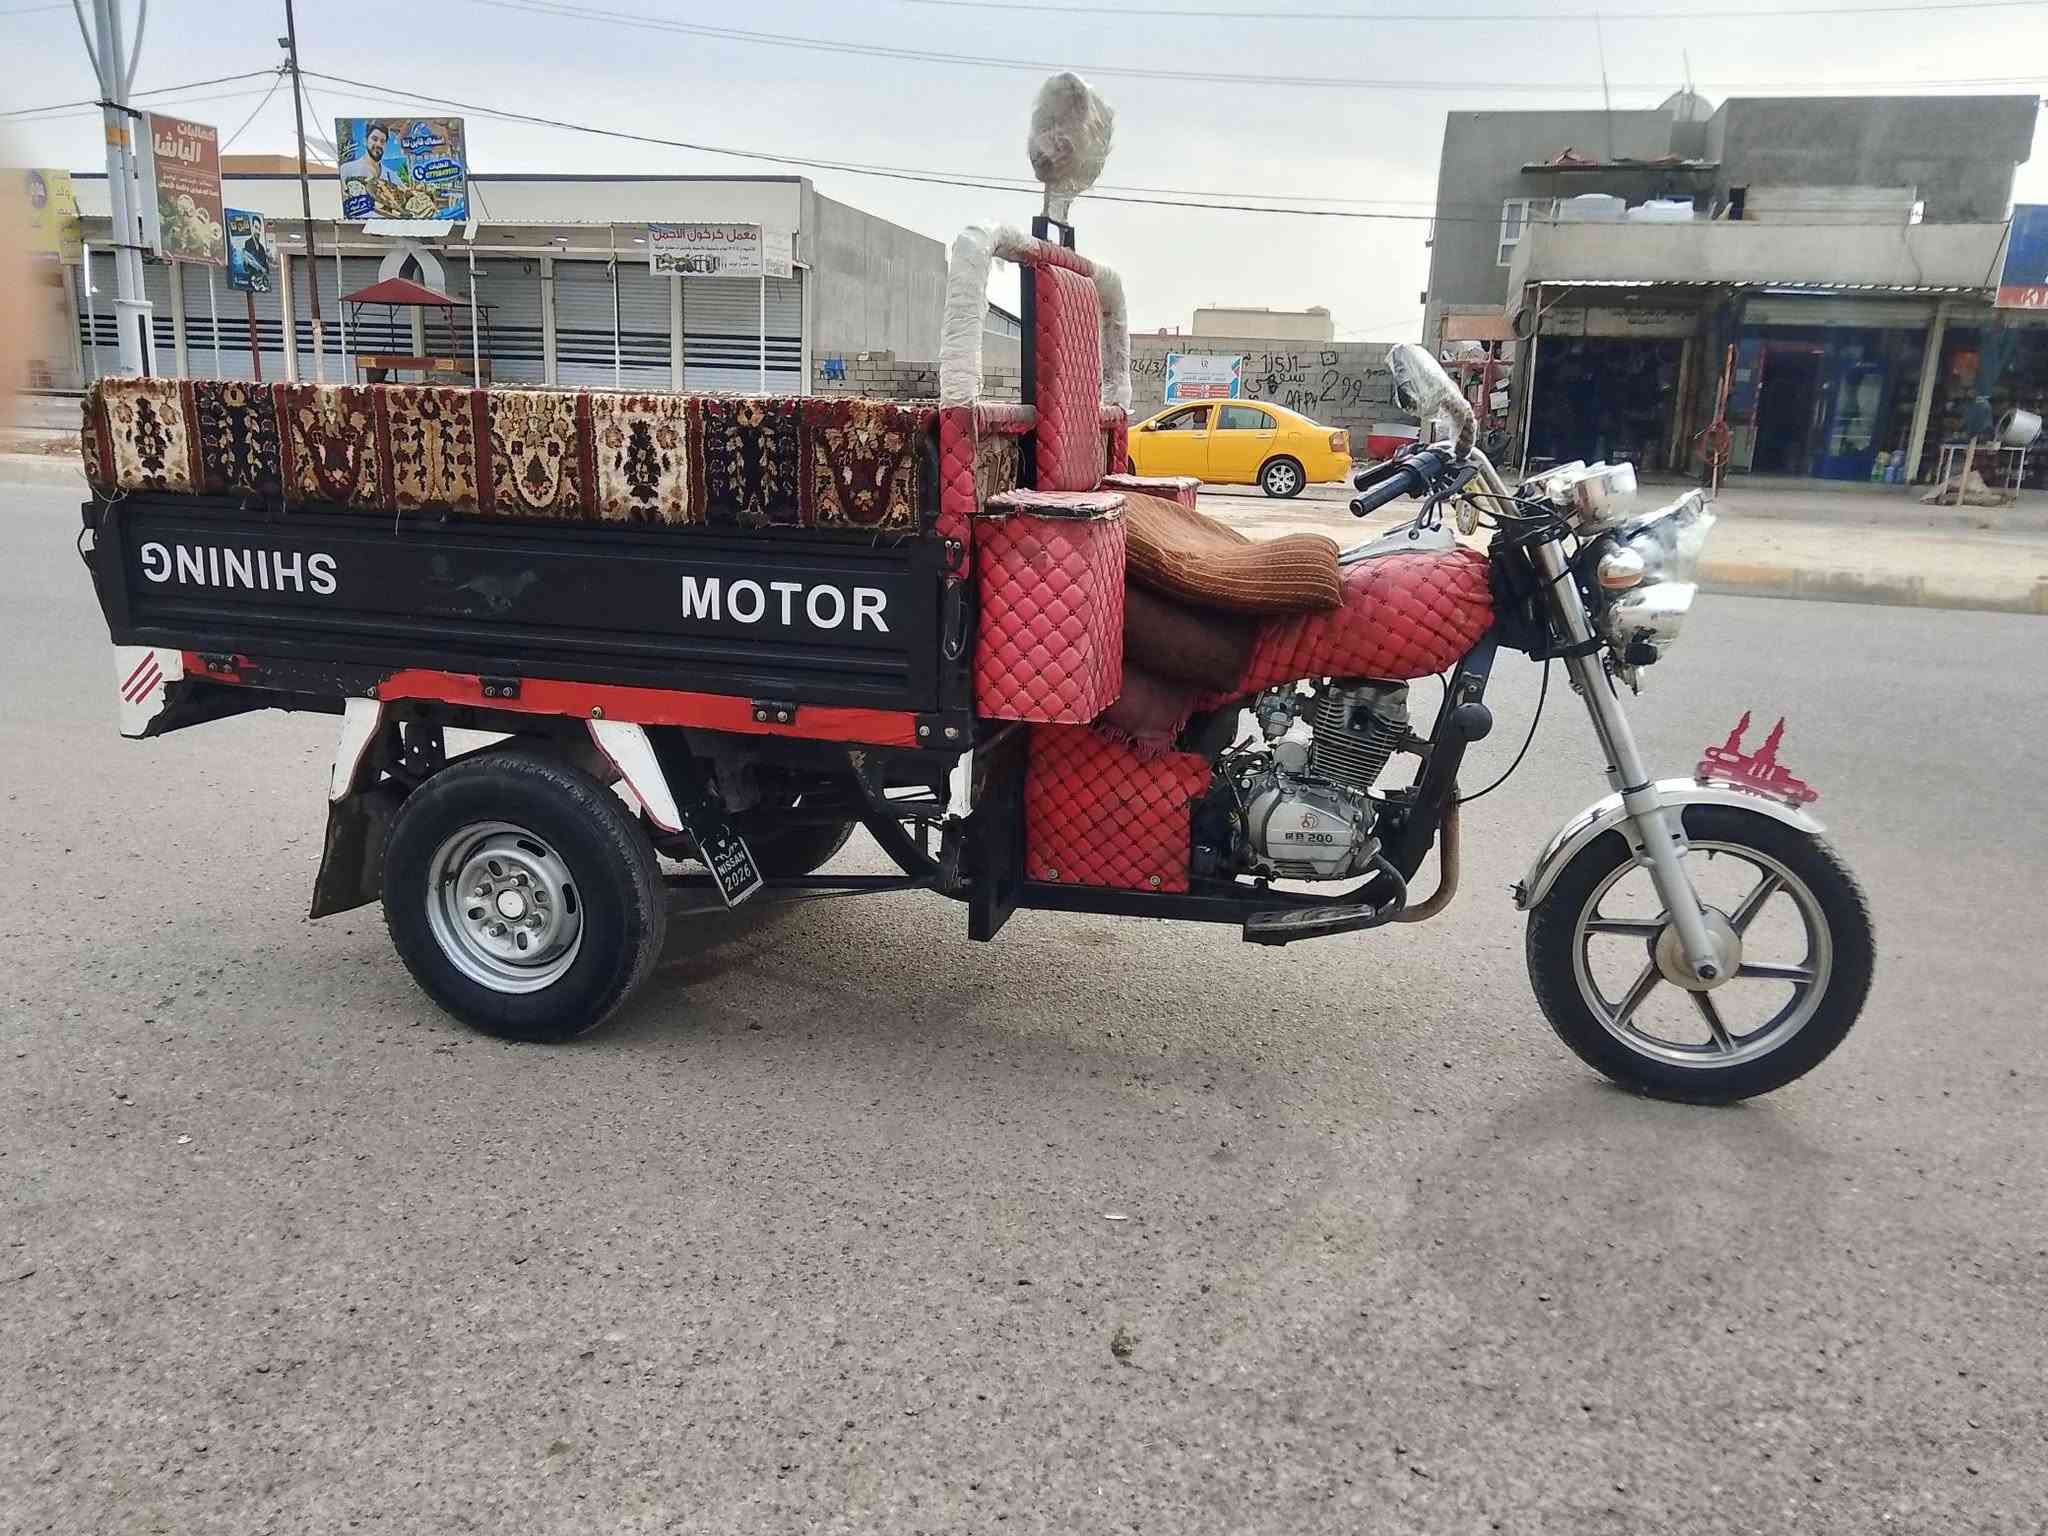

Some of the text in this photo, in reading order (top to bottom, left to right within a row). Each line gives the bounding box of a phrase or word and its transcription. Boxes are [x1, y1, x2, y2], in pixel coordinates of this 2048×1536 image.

[154, 133, 202, 167] الباشا
[727, 229, 757, 242] معمل
[140, 541, 337, 595] SHINING
[681, 575, 890, 632] MOTOR
[1308, 833, 1333, 843] 200
[717, 850, 746, 877] NISSAN
[725, 863, 751, 892] 2026
